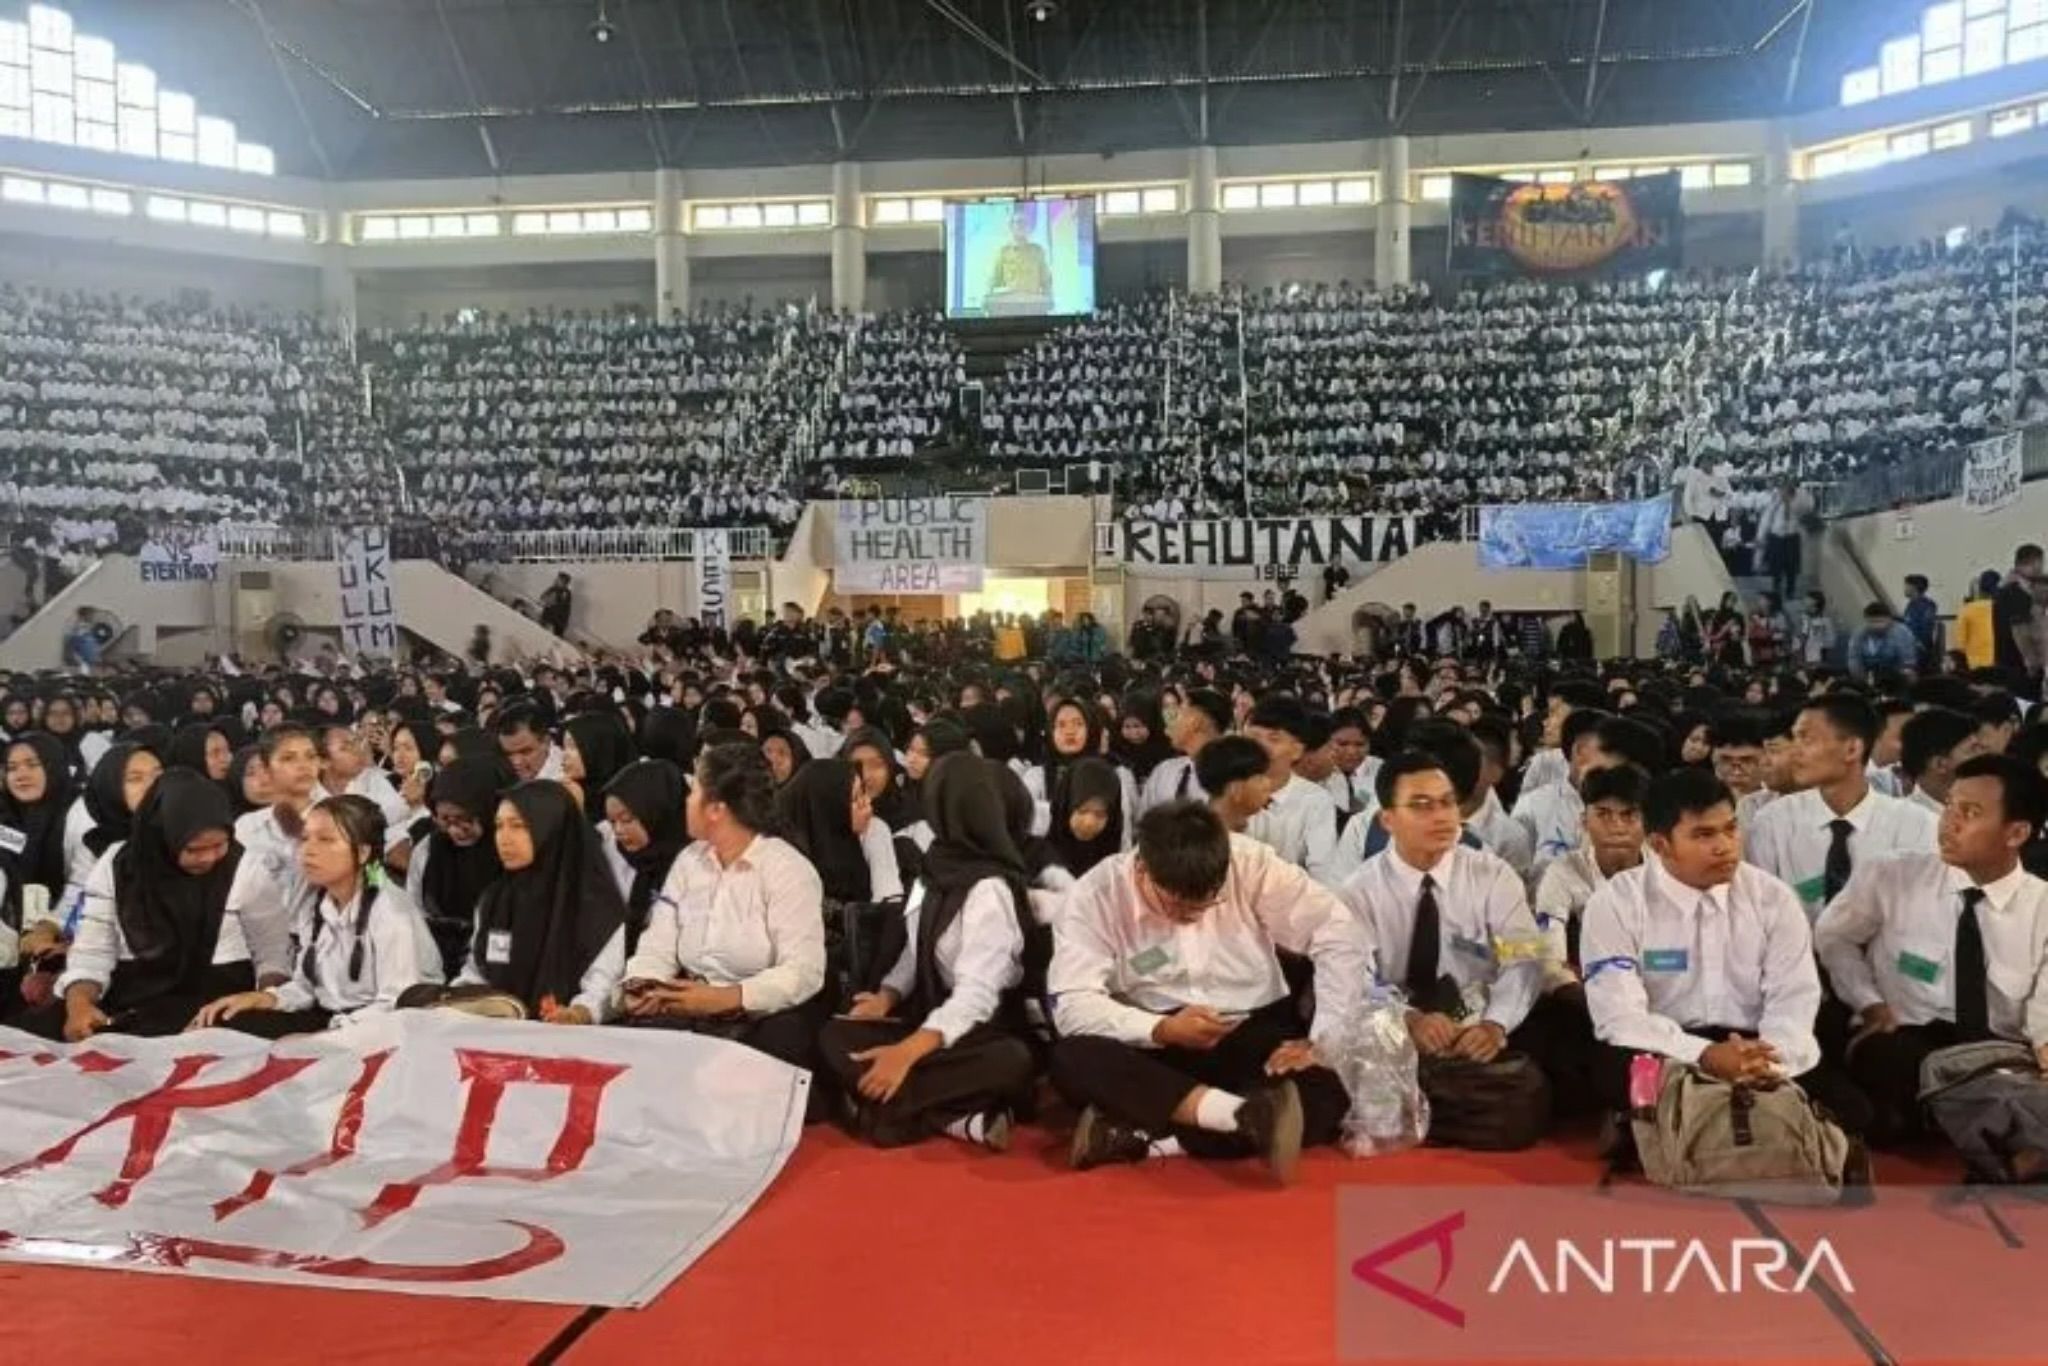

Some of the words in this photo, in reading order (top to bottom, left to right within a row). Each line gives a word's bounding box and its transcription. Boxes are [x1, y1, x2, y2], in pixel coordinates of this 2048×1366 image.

[861, 497, 974, 526] PUBLIC
[851, 527, 973, 560] HEALTH
[1123, 517, 1426, 565] KEHUTANA
[880, 562, 941, 590] AREA
